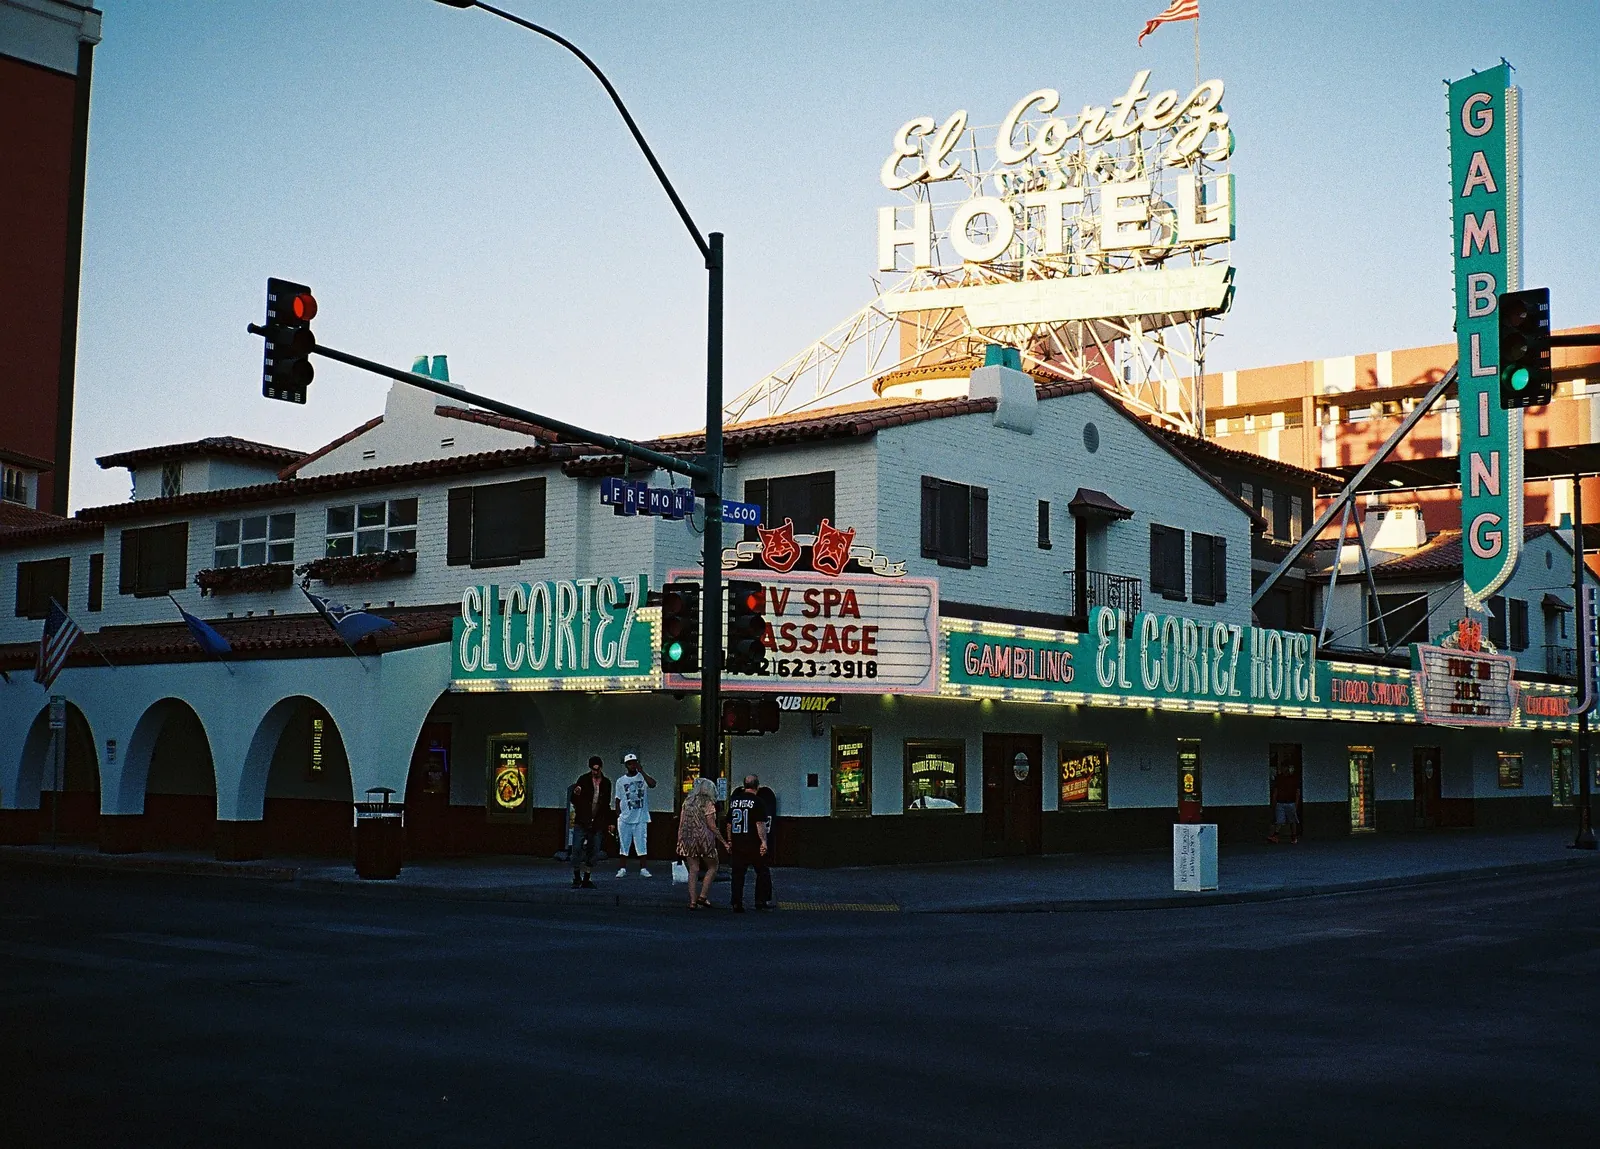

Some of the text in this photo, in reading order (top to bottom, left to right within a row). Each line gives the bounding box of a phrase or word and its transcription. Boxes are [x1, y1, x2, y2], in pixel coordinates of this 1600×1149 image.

[881, 69, 1230, 190] El Cortez
[878, 174, 1234, 271] HOTEL
[1460, 92, 1503, 559] GAMBLING
[734, 507, 756, 521] 600
[802, 588, 861, 618] SPA
[460, 576, 641, 672] EL CORTEZ
[760, 622, 879, 656] ASSAGE
[964, 642, 1075, 683] GAMBLING
[1096, 606, 1321, 703] EL CORTEZ HOTEL
[776, 695, 836, 712] SUBWAY
[1331, 678, 1410, 706] FLOOR SHOWS
[731, 808, 749, 834] 21
